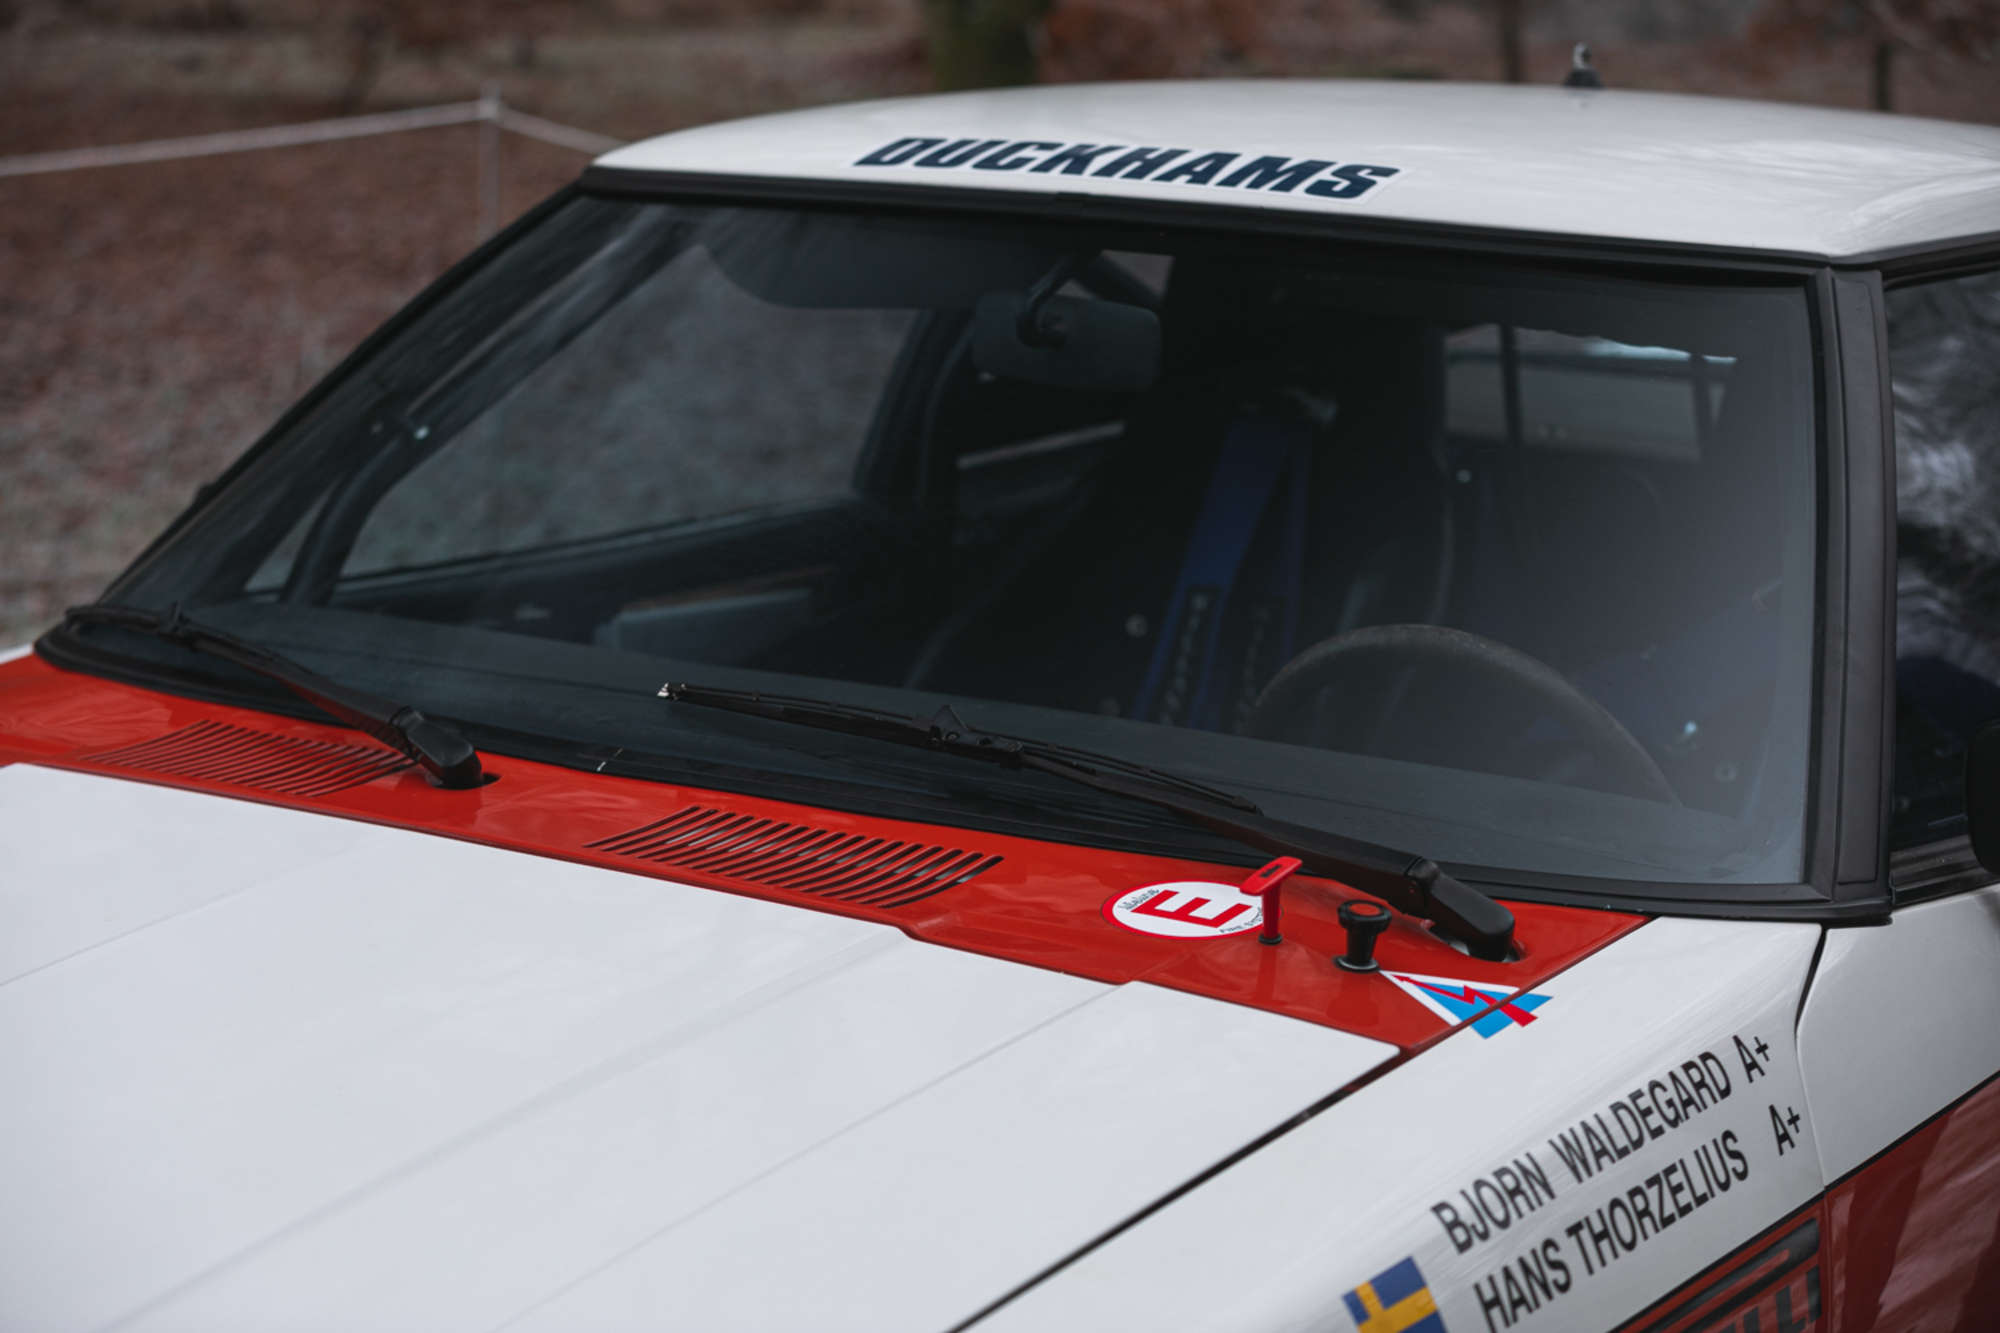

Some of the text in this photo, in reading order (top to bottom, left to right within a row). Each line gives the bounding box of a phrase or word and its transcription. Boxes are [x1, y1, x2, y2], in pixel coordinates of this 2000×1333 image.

[853, 137, 1400, 199] DUCKHAMS
[1431, 1034, 1771, 1255] BJORN WALDEGARD A+
[1473, 1238, 1573, 1333] HANS
[1565, 1129, 1749, 1276] THORZELIUS
[1768, 1103, 1802, 1156] A+
